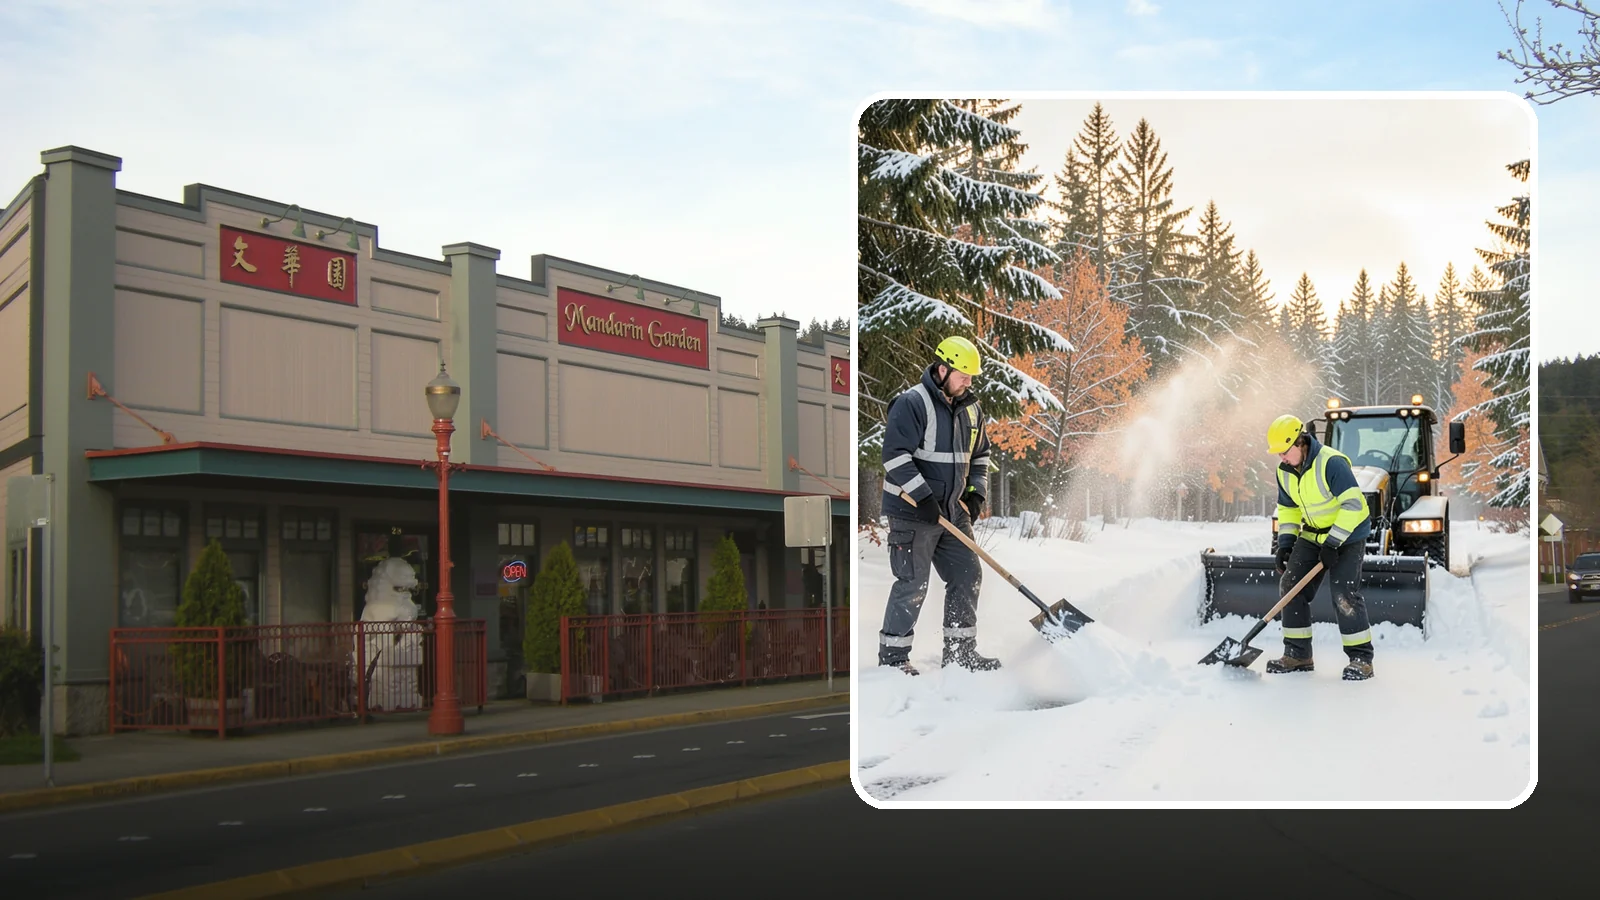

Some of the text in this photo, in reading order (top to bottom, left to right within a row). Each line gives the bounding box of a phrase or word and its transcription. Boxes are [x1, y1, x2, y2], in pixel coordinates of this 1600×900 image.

[230, 235, 346, 290] 文華園
[564, 302, 702, 352] Mandarin Garden
[503, 565, 526, 578] OPEN
